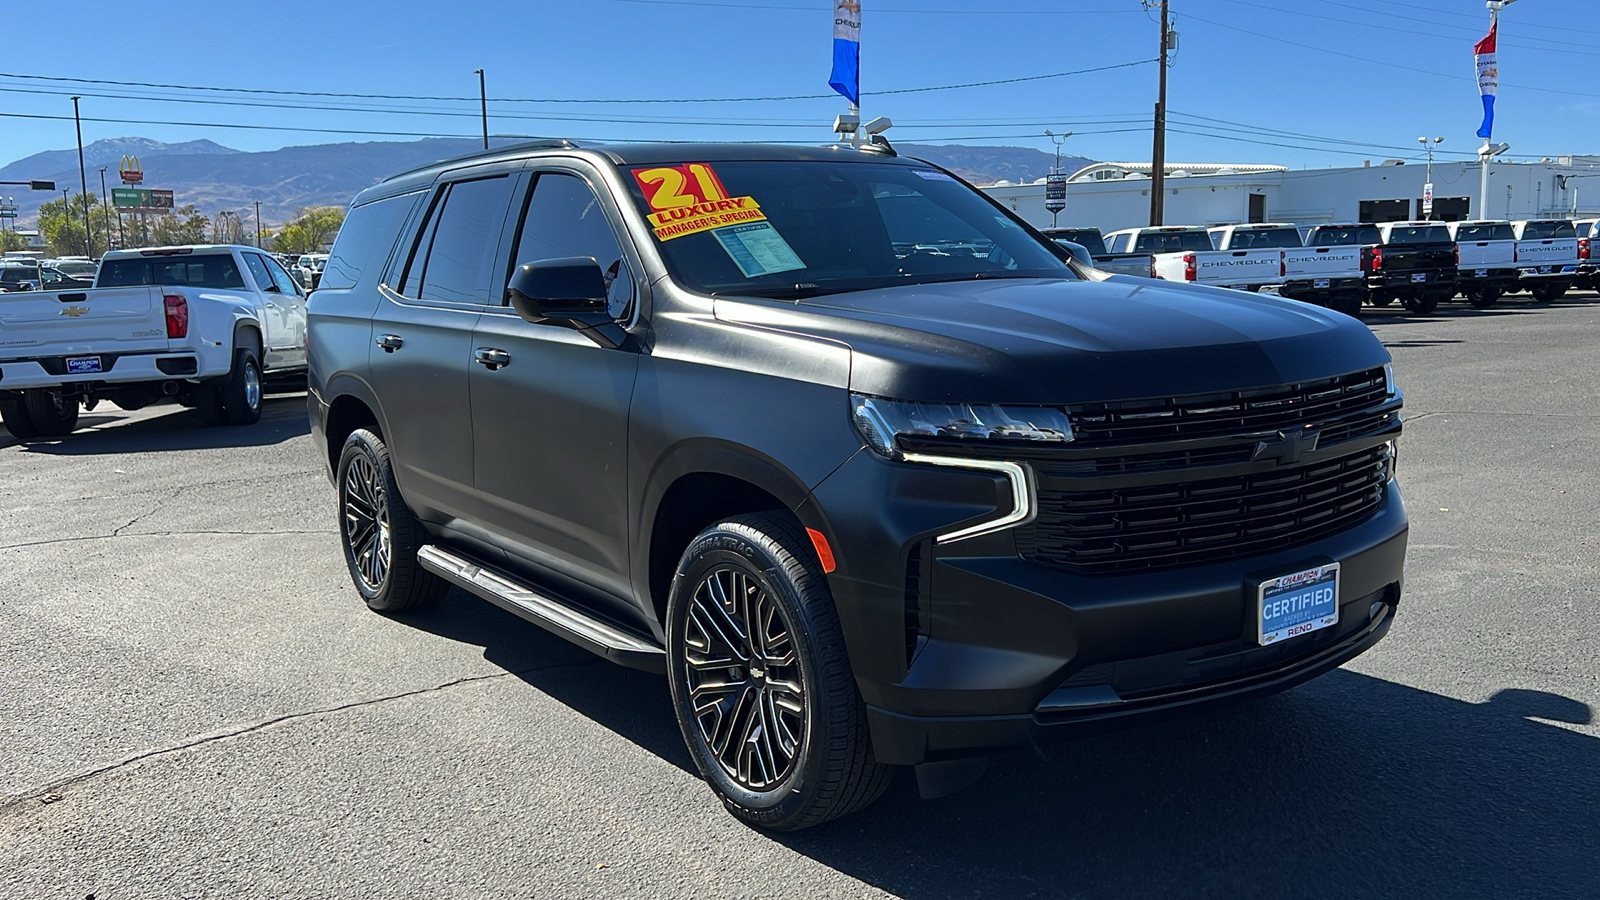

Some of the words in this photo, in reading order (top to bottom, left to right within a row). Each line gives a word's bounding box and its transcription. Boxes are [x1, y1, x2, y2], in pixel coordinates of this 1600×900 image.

[638, 164, 724, 209] 21
[656, 198, 746, 224] LUXURY
[656, 215, 718, 238] MANAGER'S
[719, 208, 761, 224] SPECIAL
[734, 224, 767, 233] CERTIFIED
[1519, 245, 1574, 253] CHEVROLET
[1202, 258, 1275, 268] CHEVROLET
[1288, 255, 1355, 263] CHEVROLET
[687, 536, 721, 561] TERRA
[722, 536, 754, 558] TRAC
[1282, 569, 1319, 586] CHAMPION
[1263, 587, 1333, 621] CERTIFIED
[1284, 612, 1304, 622] BACKED
[1288, 623, 1313, 637] RENO
